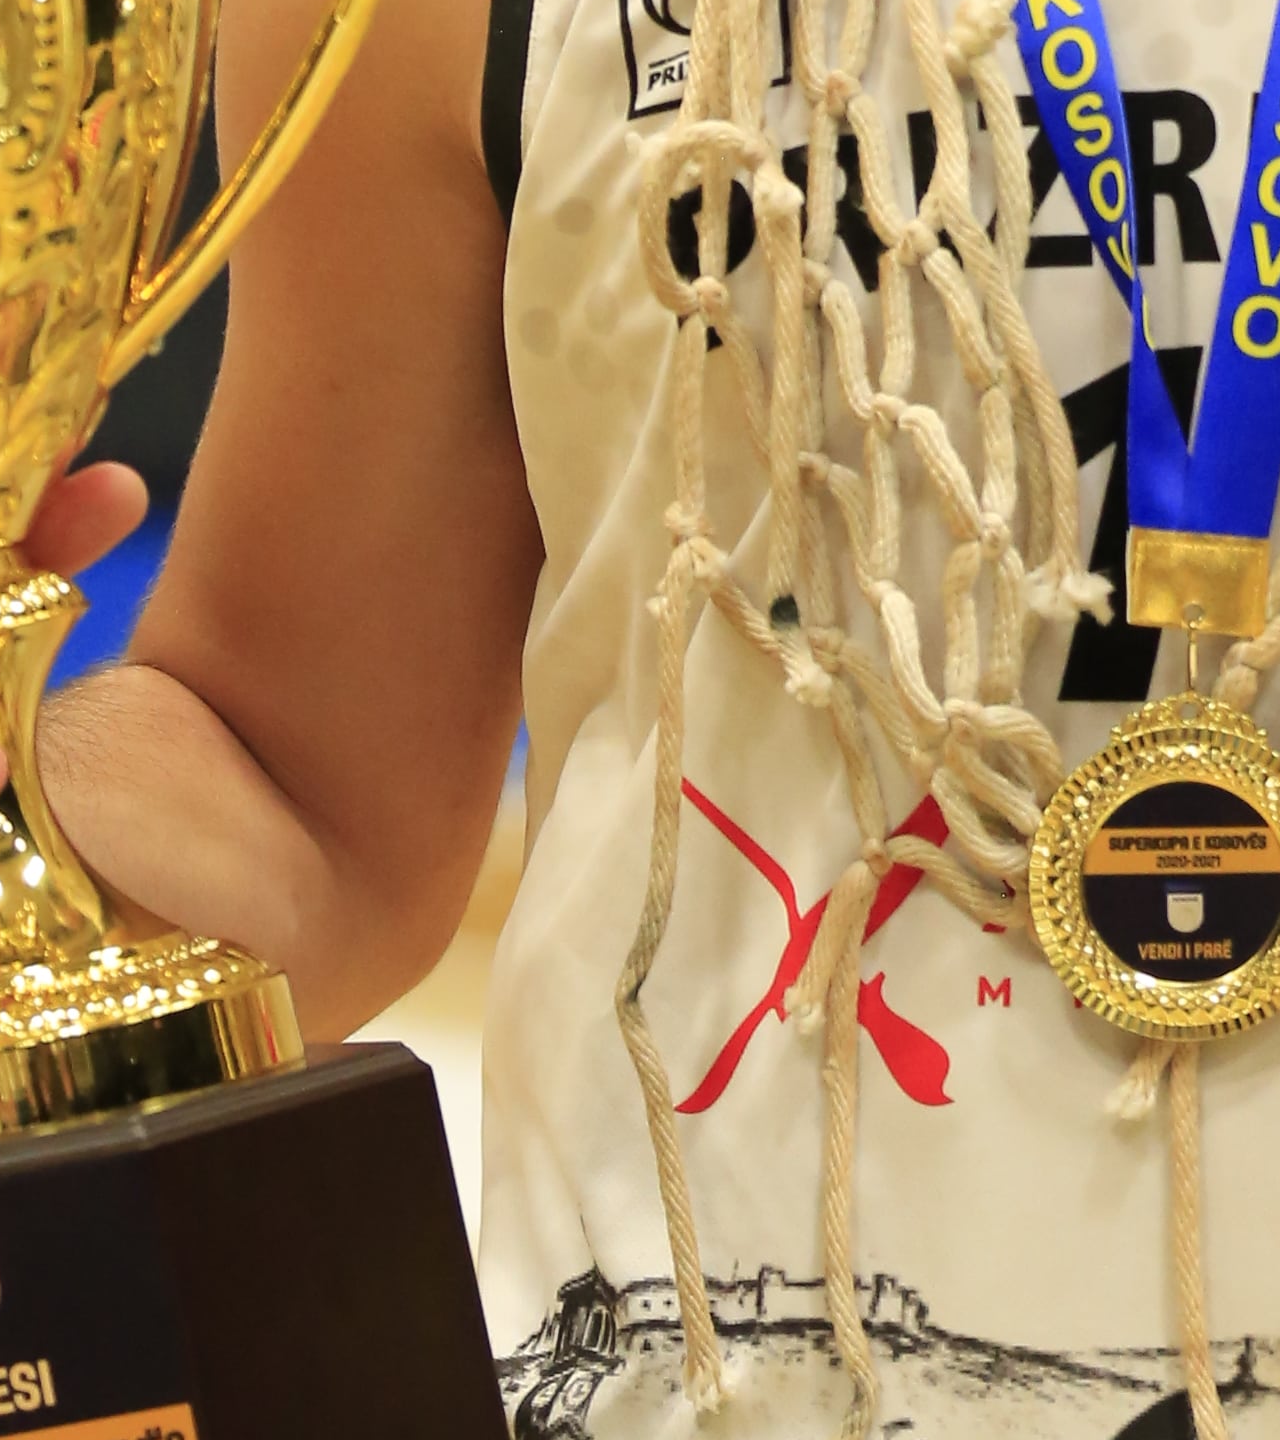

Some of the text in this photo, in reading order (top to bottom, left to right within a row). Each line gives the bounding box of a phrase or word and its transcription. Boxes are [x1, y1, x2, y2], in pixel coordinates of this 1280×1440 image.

[1109, 835, 1189, 851] SUPERKUPA
[1192, 835, 1202, 850] E
[1156, 854, 1222, 869] 2020-2021
[1138, 942, 1182, 960] VENDI
[1194, 938, 1233, 960] PARË
